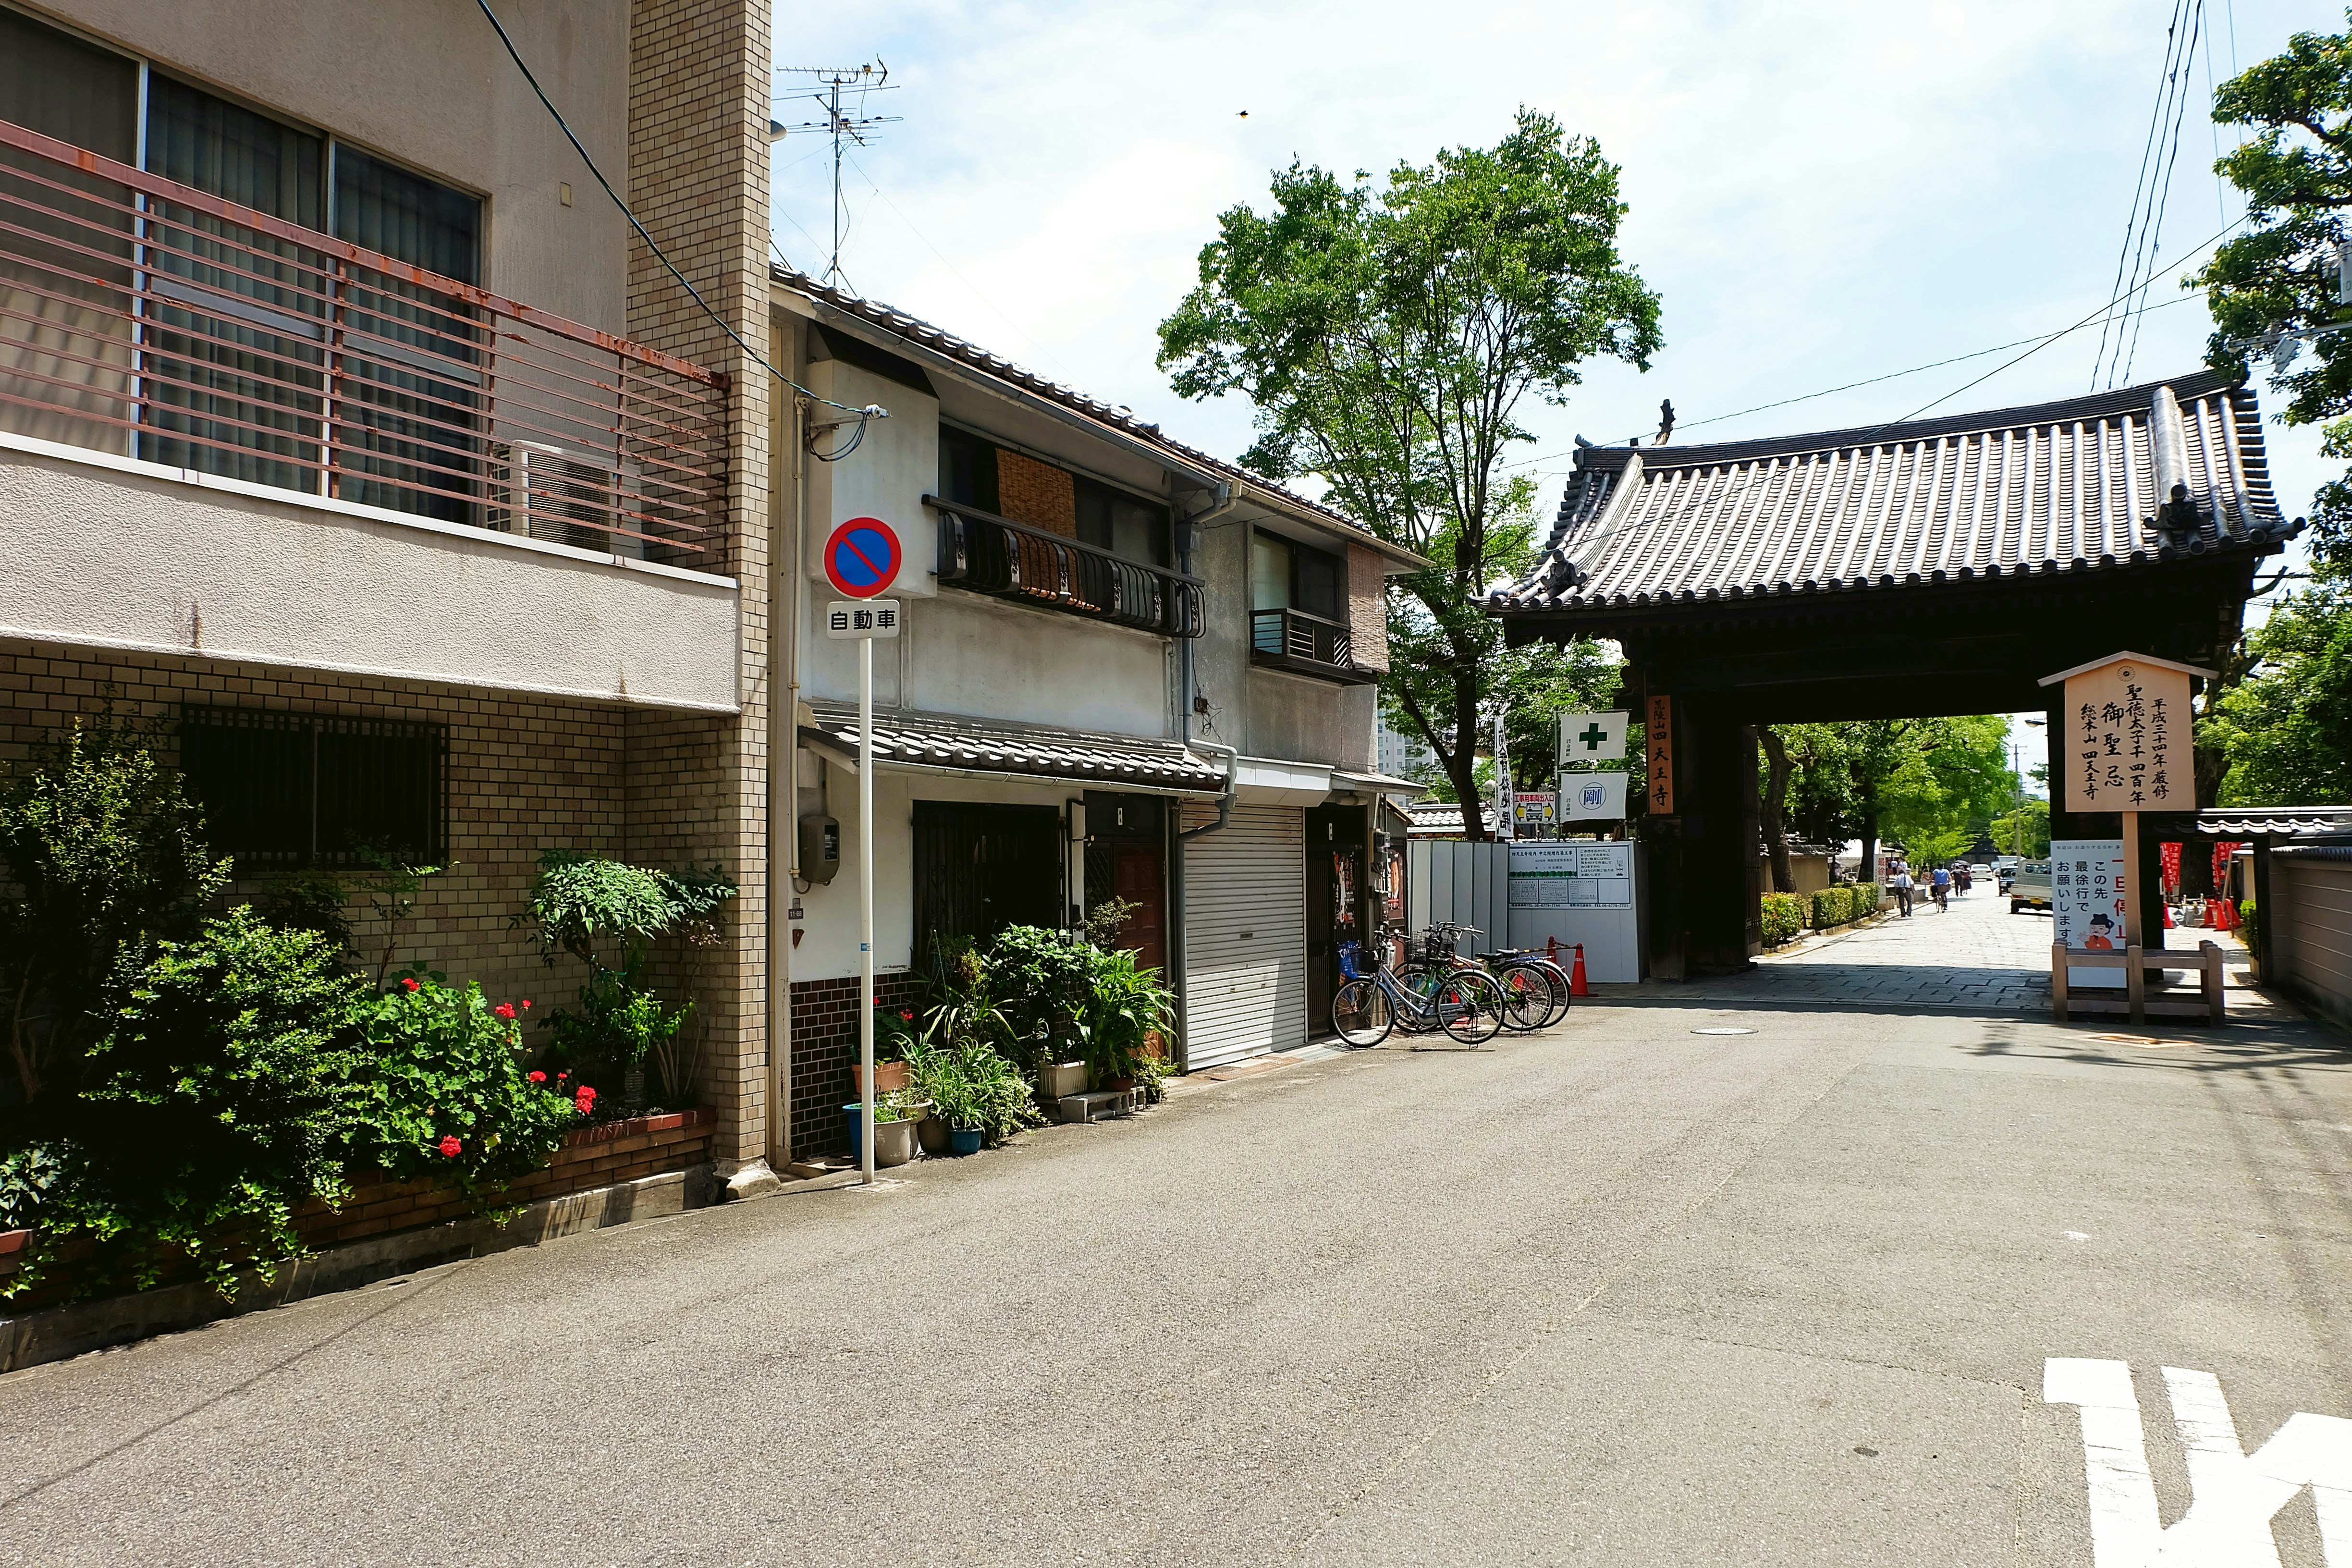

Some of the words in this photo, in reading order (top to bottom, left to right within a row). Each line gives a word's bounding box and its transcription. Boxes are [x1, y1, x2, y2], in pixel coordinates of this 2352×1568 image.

[831, 609, 896, 630] 自動車
[2100, 702, 2125, 787] 御聖忌
[2125, 684, 2146, 807] 聖徳太子千四百年
[2151, 698, 2170, 799] 平成三十四年厳修
[1514, 794, 1554, 802] 工事用車両出入口
[2075, 861, 2089, 912] 最徐行で
[2094, 861, 2108, 899] この先
